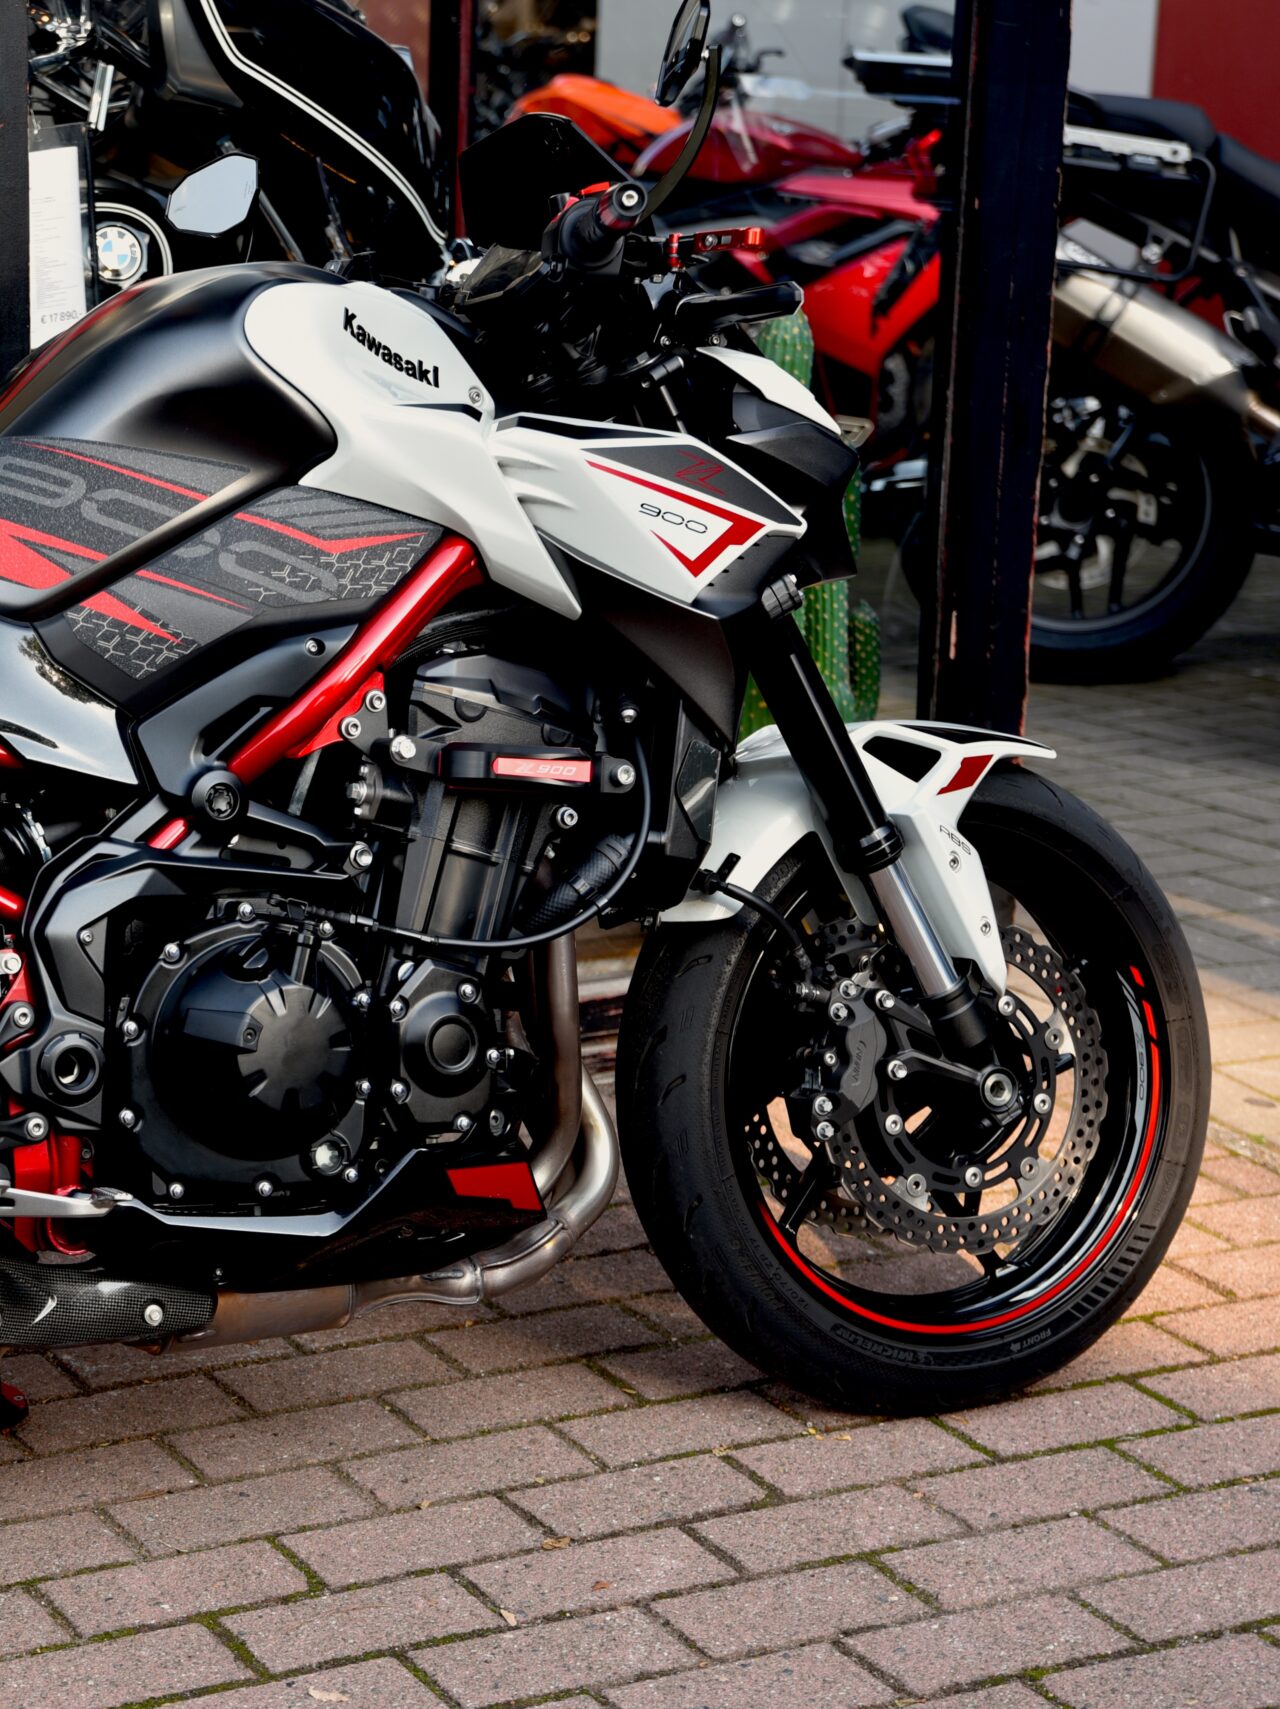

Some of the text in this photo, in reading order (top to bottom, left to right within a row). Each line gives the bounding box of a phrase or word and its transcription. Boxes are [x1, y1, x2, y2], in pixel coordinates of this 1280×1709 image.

[343, 306, 440, 389] Kawasaki
[638, 502, 708, 534] 900
[939, 824, 972, 856] ABS
